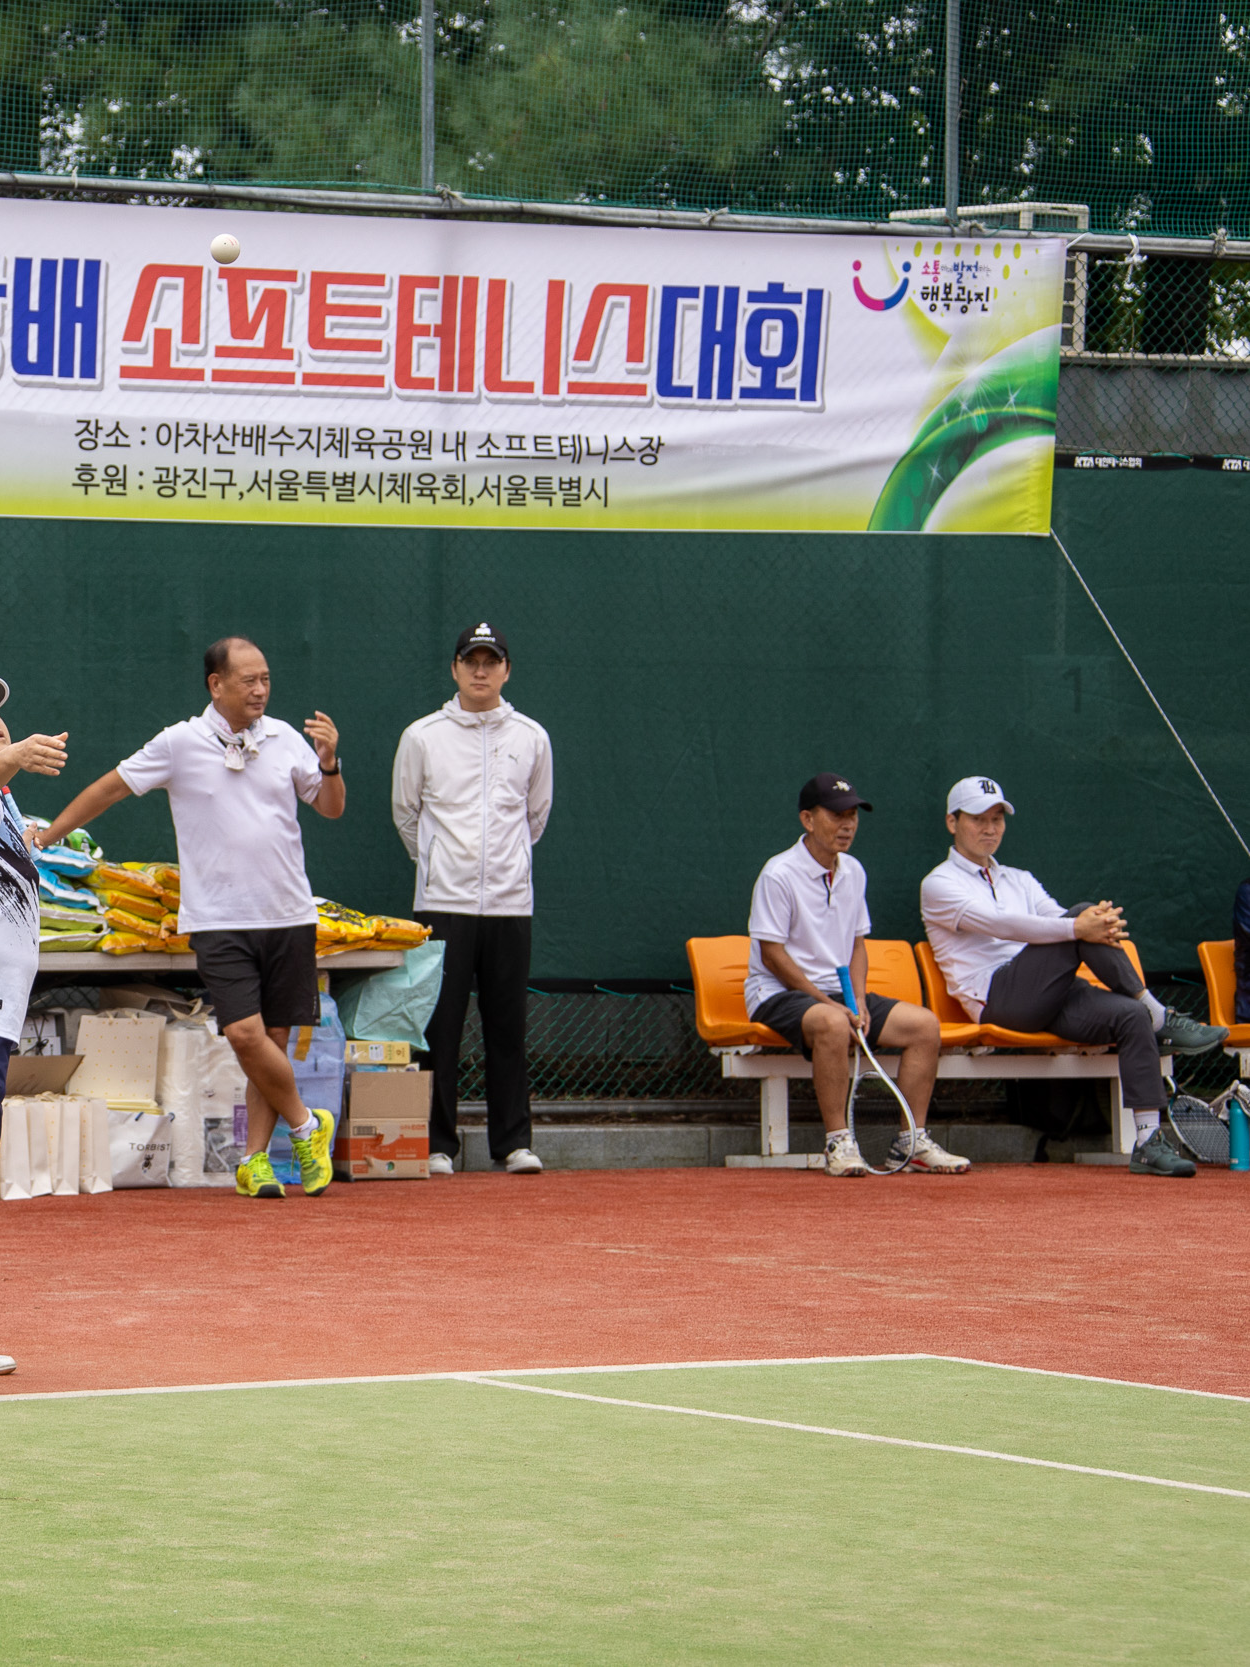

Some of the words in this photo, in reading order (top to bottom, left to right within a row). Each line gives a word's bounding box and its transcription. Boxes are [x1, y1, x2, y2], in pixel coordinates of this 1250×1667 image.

[920, 282, 990, 314] 행복광진
[118, 263, 824, 403] 소프트테니스대회
[73, 418, 132, 452] 장소
[155, 421, 433, 461] 아차산배수지체육공원
[441, 431, 468, 462] 내
[475, 433, 666, 466] 소프트테니스장
[71, 462, 129, 497] 후원
